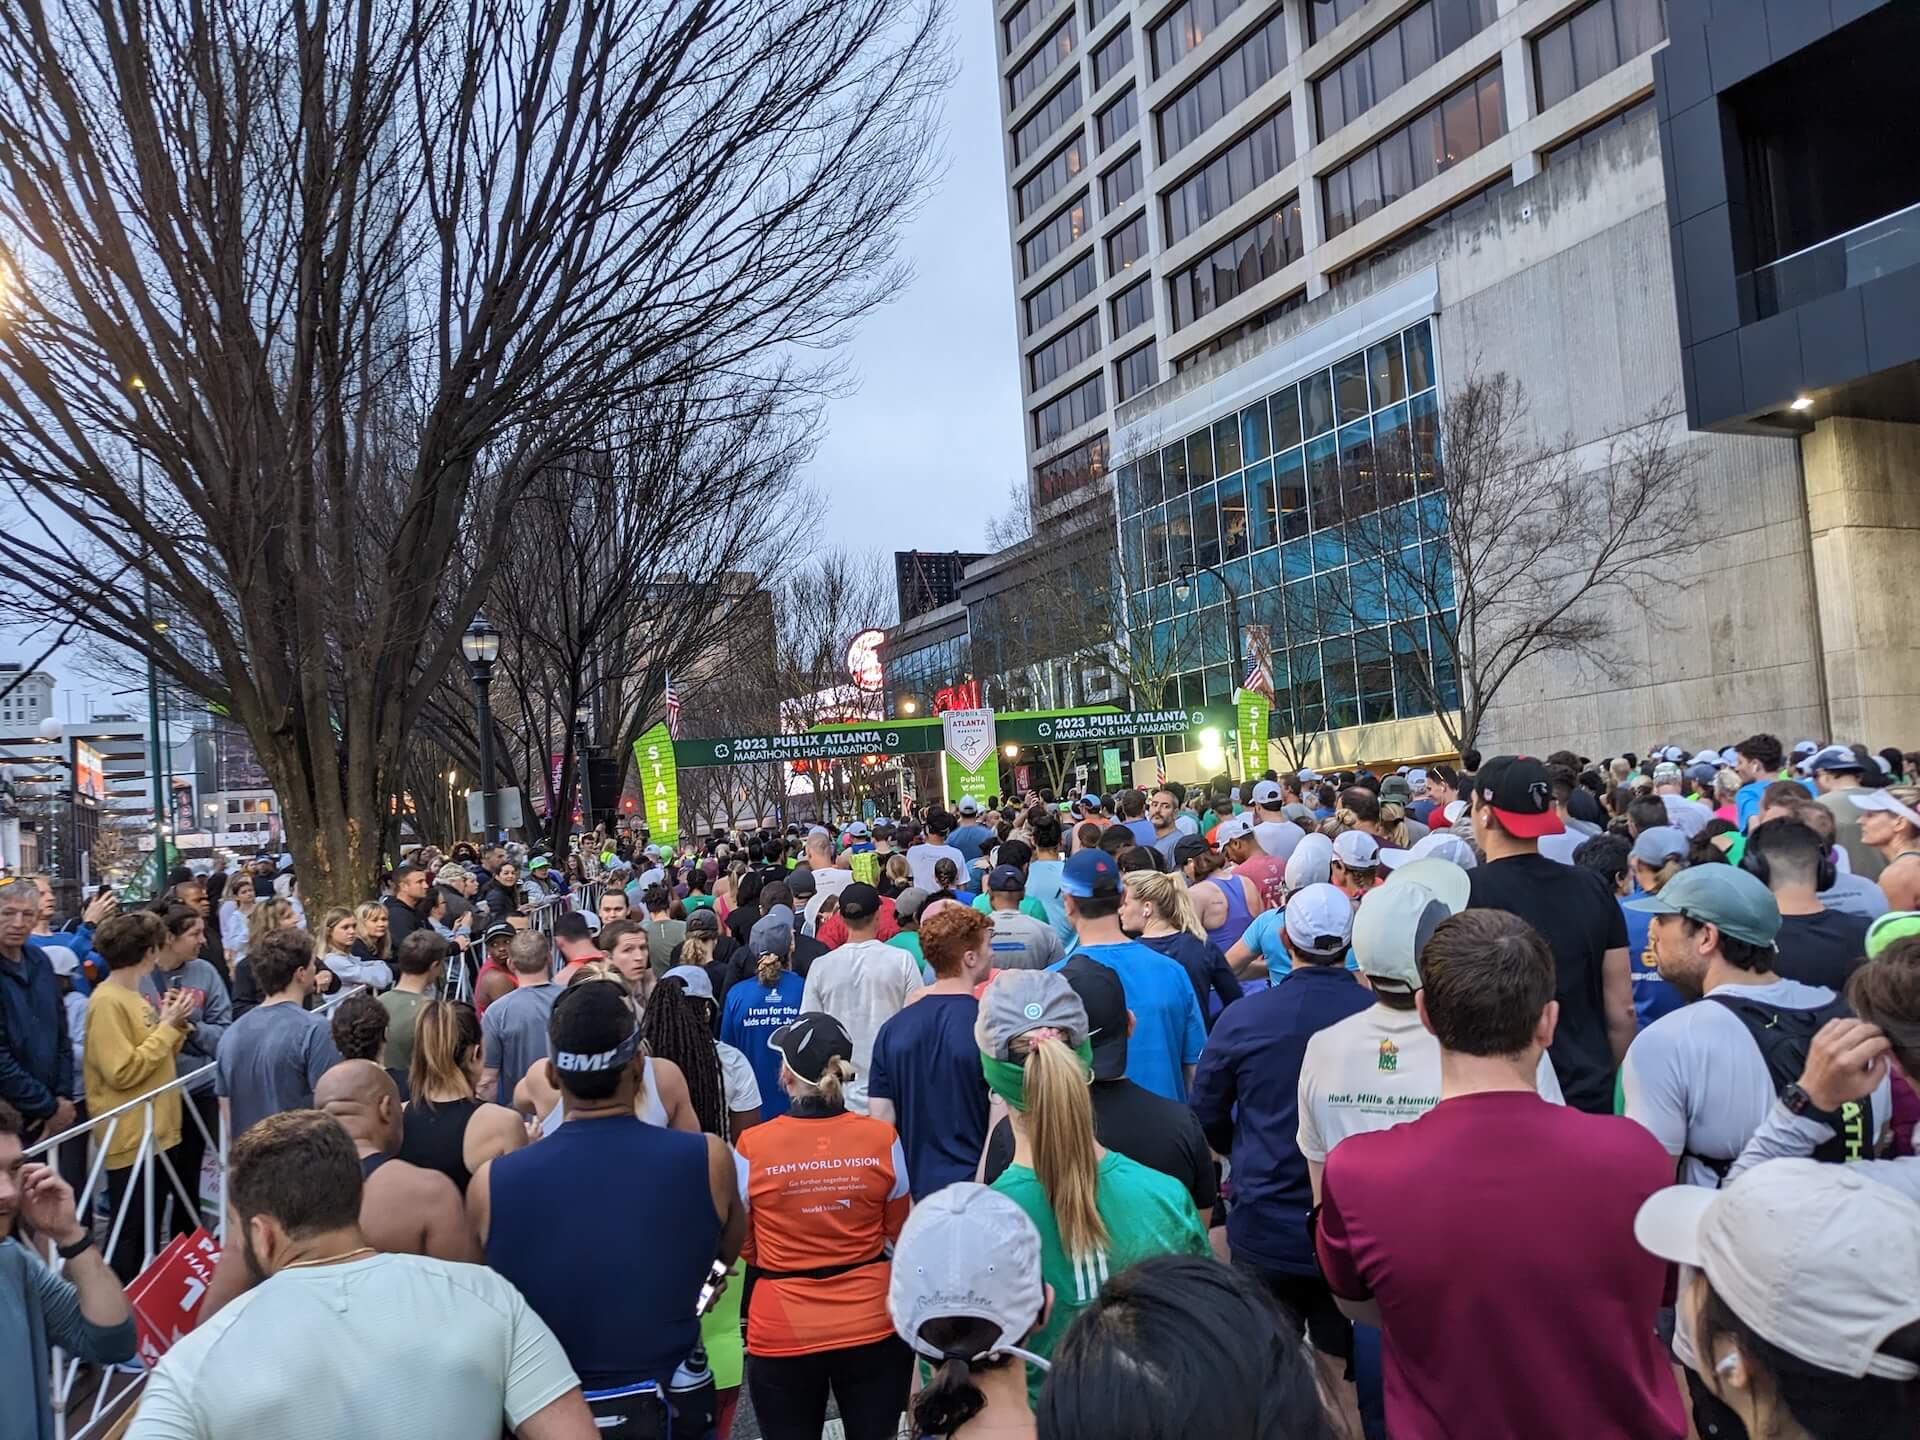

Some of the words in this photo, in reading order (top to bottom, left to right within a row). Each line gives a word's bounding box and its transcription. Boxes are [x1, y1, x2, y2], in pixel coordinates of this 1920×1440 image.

[1055, 718, 1085, 729] 2023
[1091, 714, 1132, 726] PUBLIX
[1136, 711, 1187, 723] ATLANTA
[1055, 727, 1106, 740] MARATHON
[1109, 727, 1116, 736] &
[1117, 724, 1138, 735] HALF
[1139, 721, 1189, 733] MARATHON
[733, 738, 767, 750] 2023
[773, 735, 820, 747] PUBLIX
[824, 731, 881, 744] ATLANTA
[1249, 706, 1261, 780] START
[733, 749, 791, 762] MARATHON
[793, 748, 801, 758] &
[803, 745, 828, 757] HALF
[827, 743, 882, 755] MARATHON
[648, 745, 669, 833] START
[753, 1007, 768, 1016] run
[769, 1006, 783, 1015] for
[783, 1006, 798, 1015] the
[760, 1017, 770, 1025] of
[771, 1017, 782, 1025] St.
[1357, 1093, 1382, 1104] Hills
[1386, 1096, 1394, 1104] &
[765, 1163, 796, 1176] TEAM
[799, 1159, 842, 1171] WORLD
[844, 1157, 880, 1168] VISION
[802, 1205, 822, 1214] World
